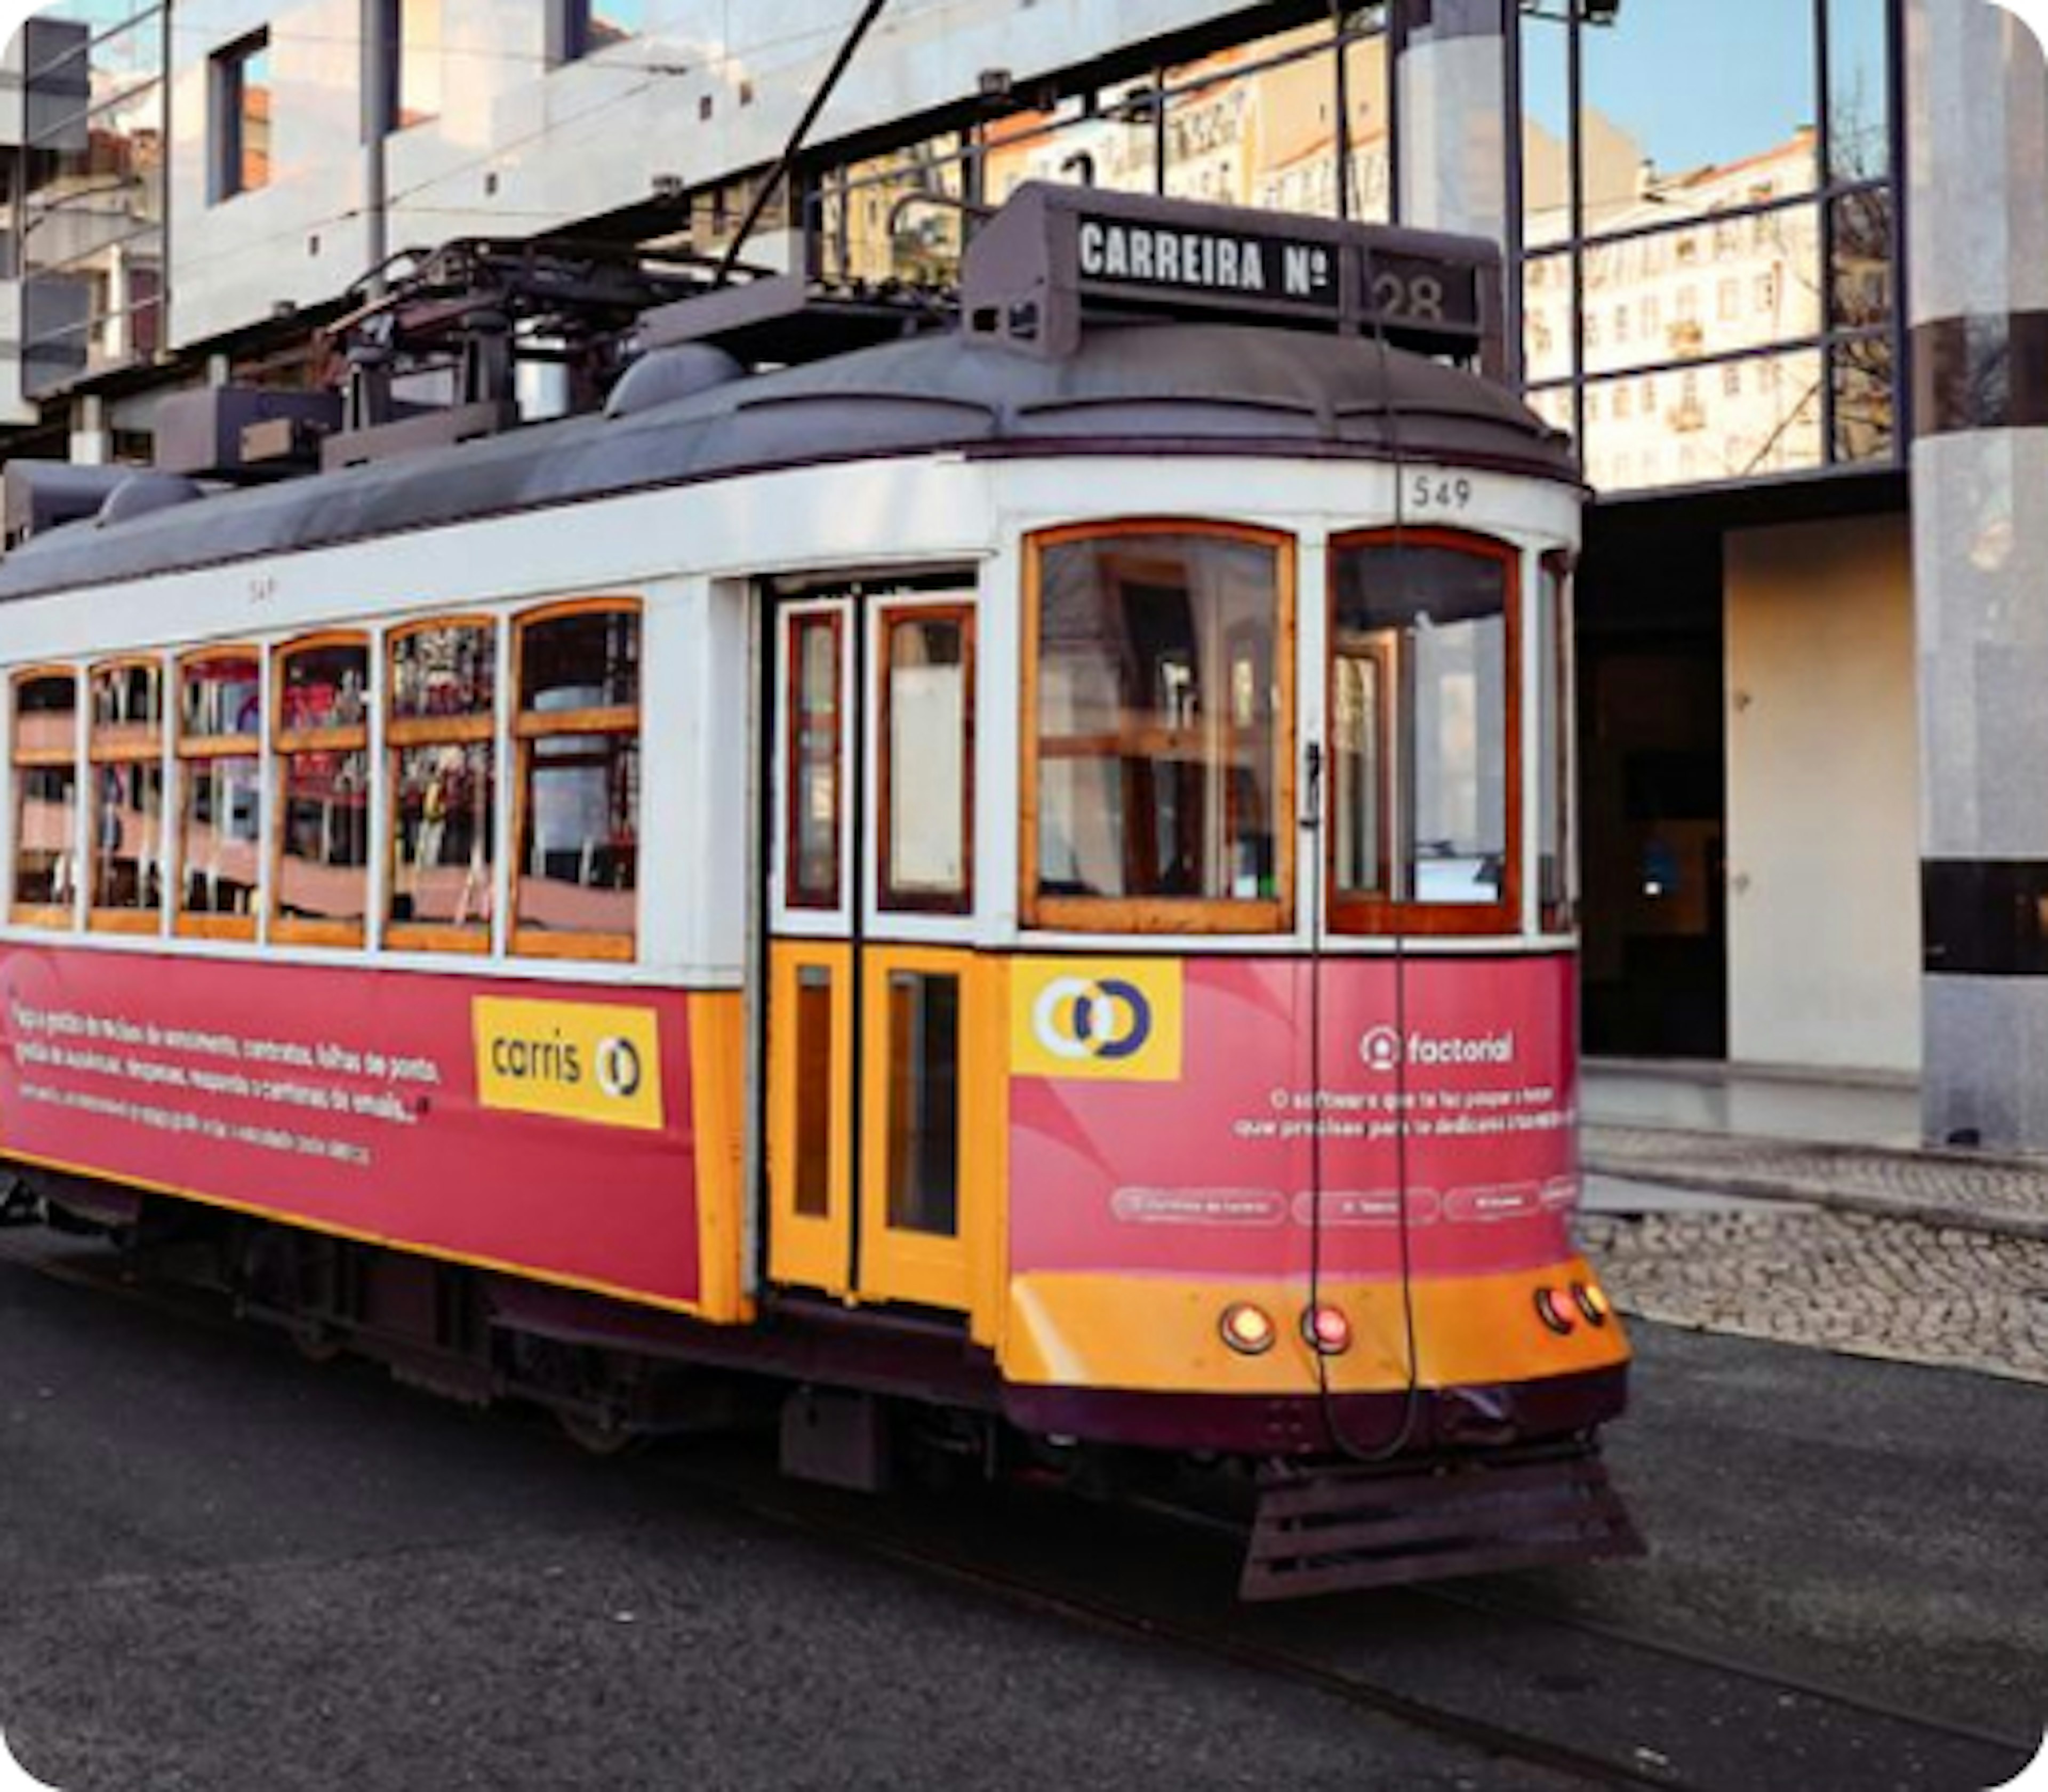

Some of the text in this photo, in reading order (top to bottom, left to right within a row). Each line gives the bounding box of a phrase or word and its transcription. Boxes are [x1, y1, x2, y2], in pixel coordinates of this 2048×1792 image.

[1080, 222, 1264, 290] CARREIRA
[1372, 272, 1443, 319] 28
[1413, 475, 1470, 509] 549
[492, 1028, 580, 1083] carris
[1409, 1029, 1514, 1063] factorial
